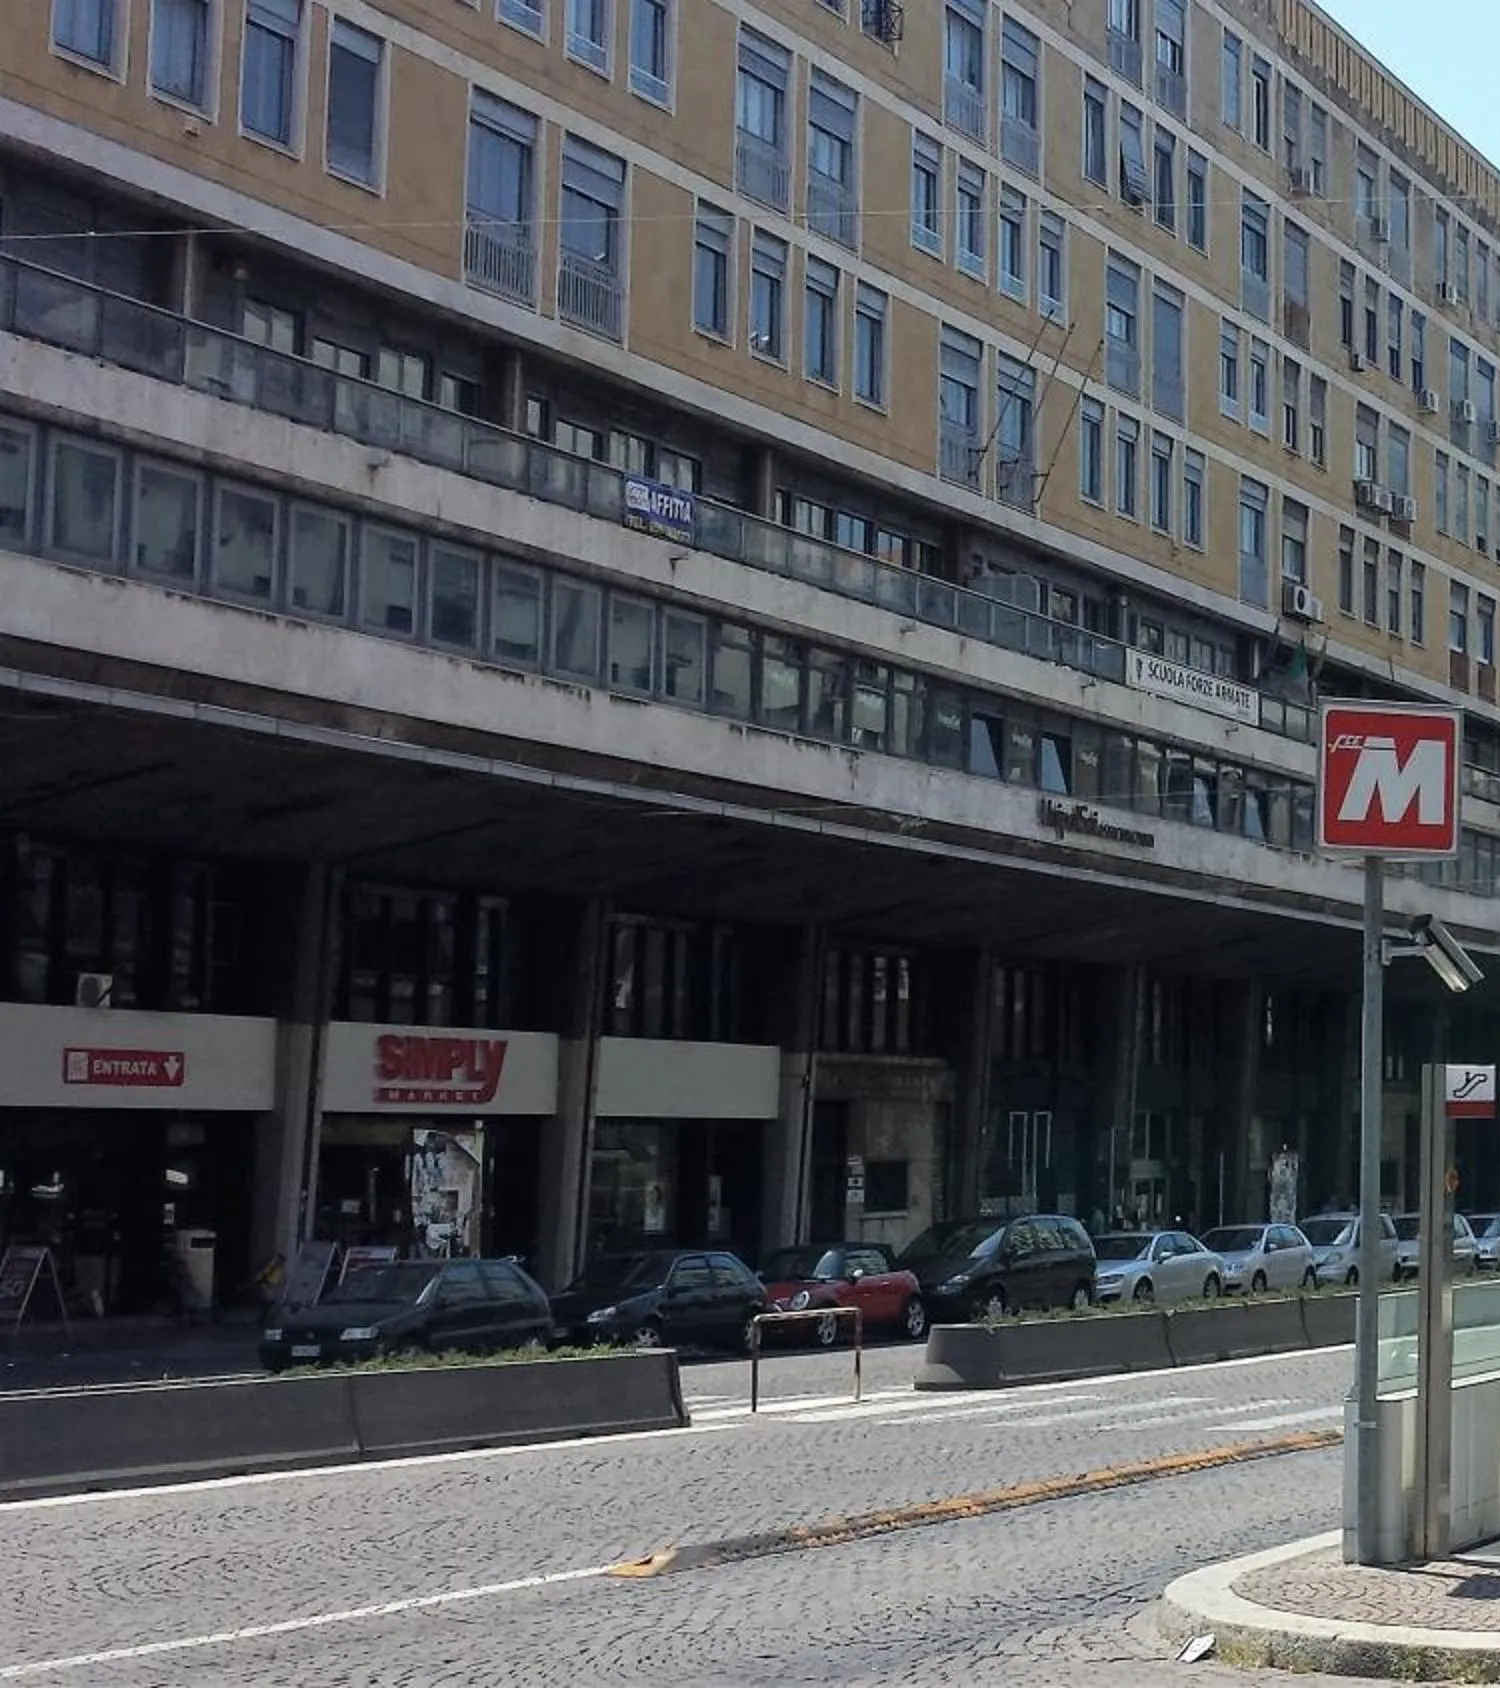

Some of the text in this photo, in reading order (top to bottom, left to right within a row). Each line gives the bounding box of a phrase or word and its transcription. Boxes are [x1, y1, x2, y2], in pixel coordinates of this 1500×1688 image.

[1149, 661, 1250, 709] SCUOLA FORZE ARMATE
[1337, 735, 1446, 825] M
[93, 1060, 157, 1077] ENTRATA
[375, 1034, 508, 1103] SIMPLY
[388, 1090, 482, 1101] MARKET
